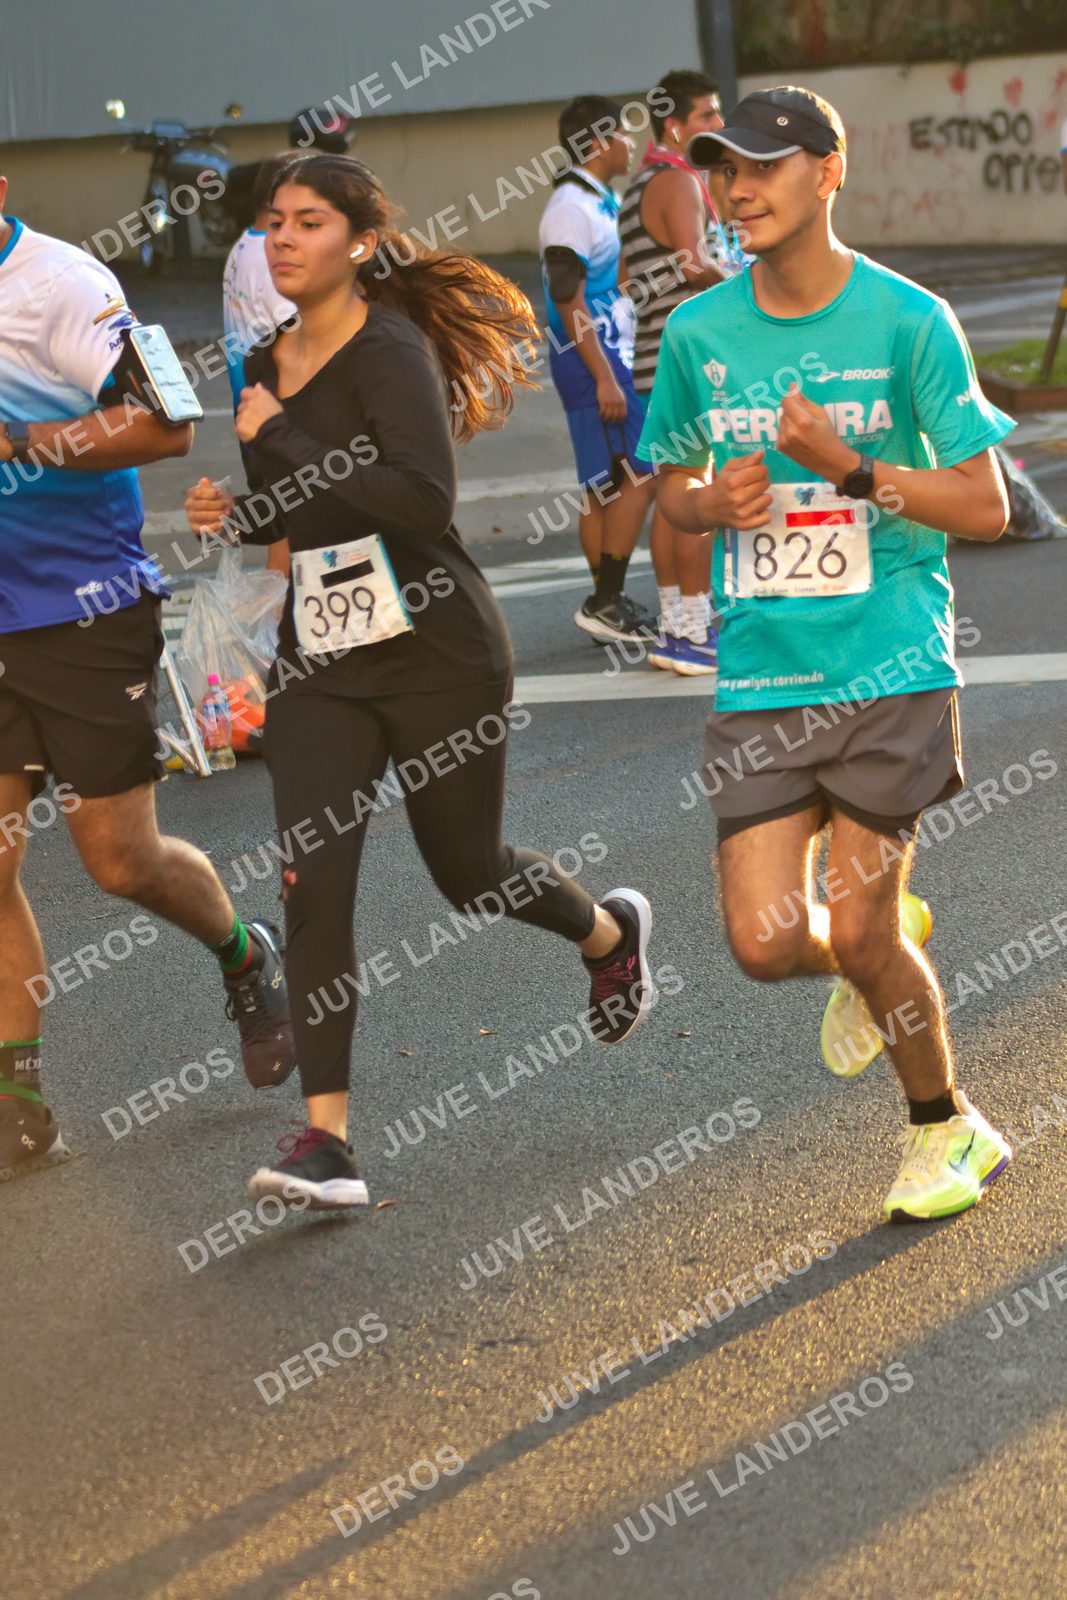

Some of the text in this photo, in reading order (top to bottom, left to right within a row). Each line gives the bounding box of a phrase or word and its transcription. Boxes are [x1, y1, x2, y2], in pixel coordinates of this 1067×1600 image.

[753, 531, 847, 582] 826
[303, 586, 376, 638] 399
[773, 670, 824, 686] corriendo
